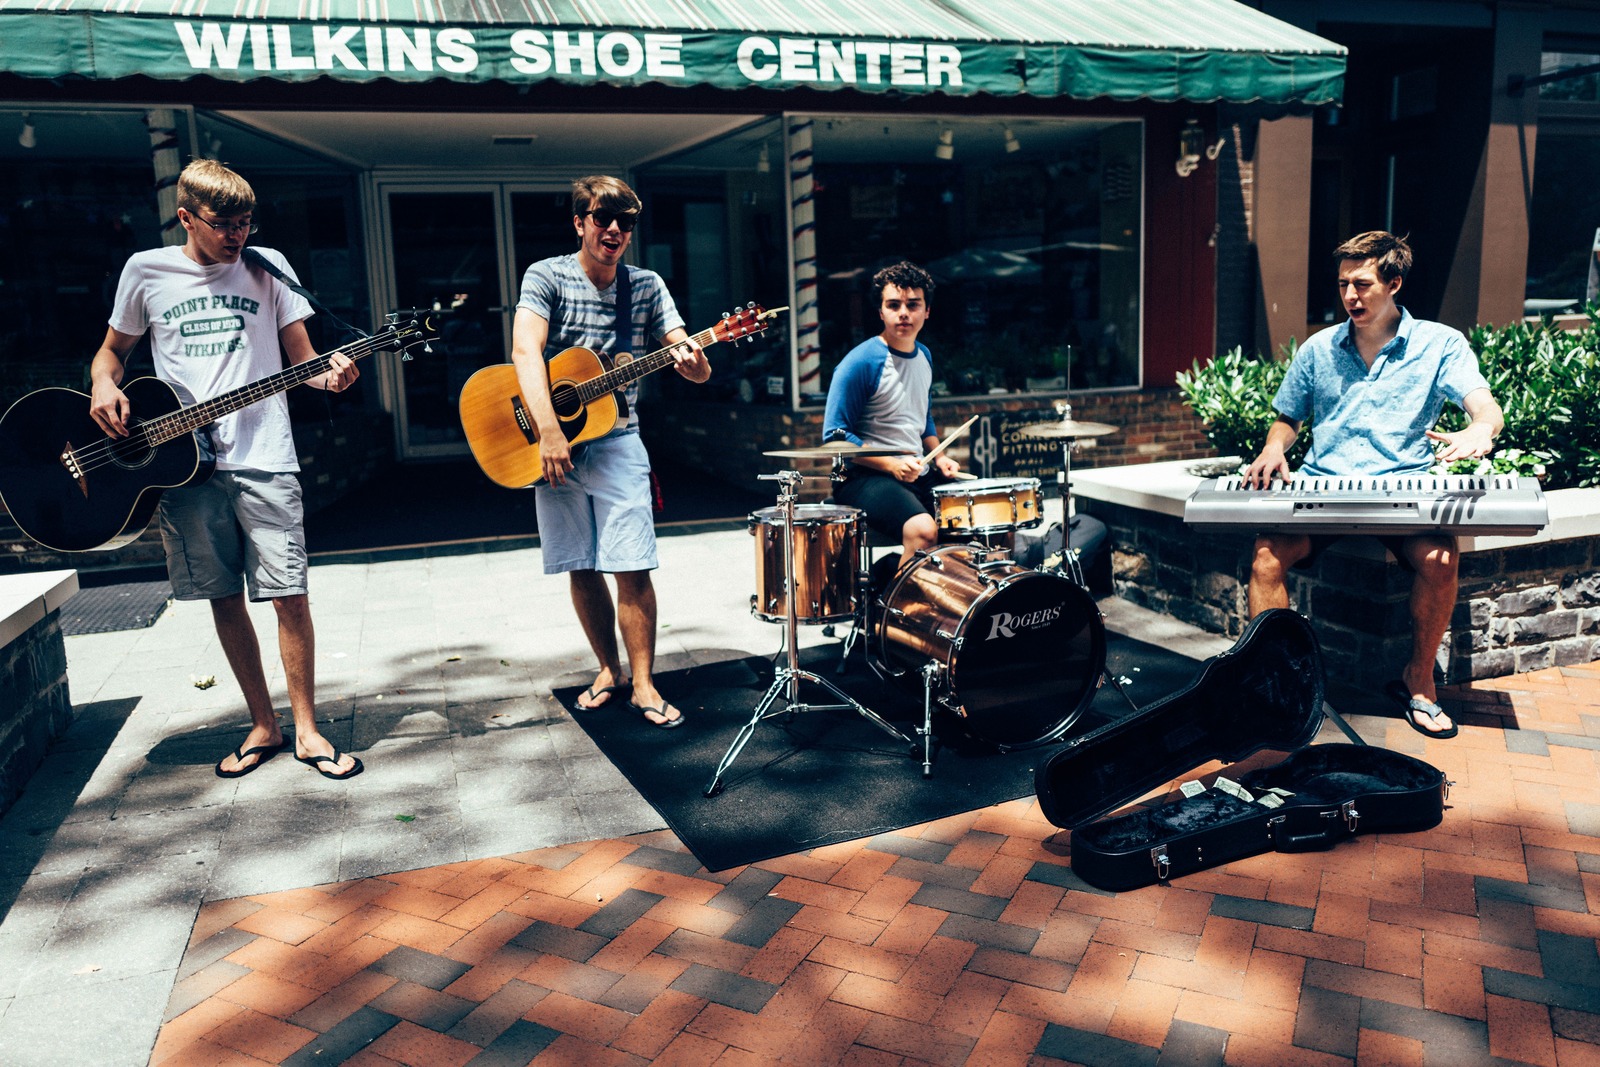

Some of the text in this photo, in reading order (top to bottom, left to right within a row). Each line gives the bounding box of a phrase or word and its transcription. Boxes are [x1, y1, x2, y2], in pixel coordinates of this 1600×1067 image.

[174, 22, 963, 86] WILKINS SHOE CENTER
[163, 295, 260, 324] POINT PLACE
[184, 337, 244, 357] VIKINGS
[1002, 441, 1058, 455] FITTING
[985, 606, 1061, 641] ROGERS
